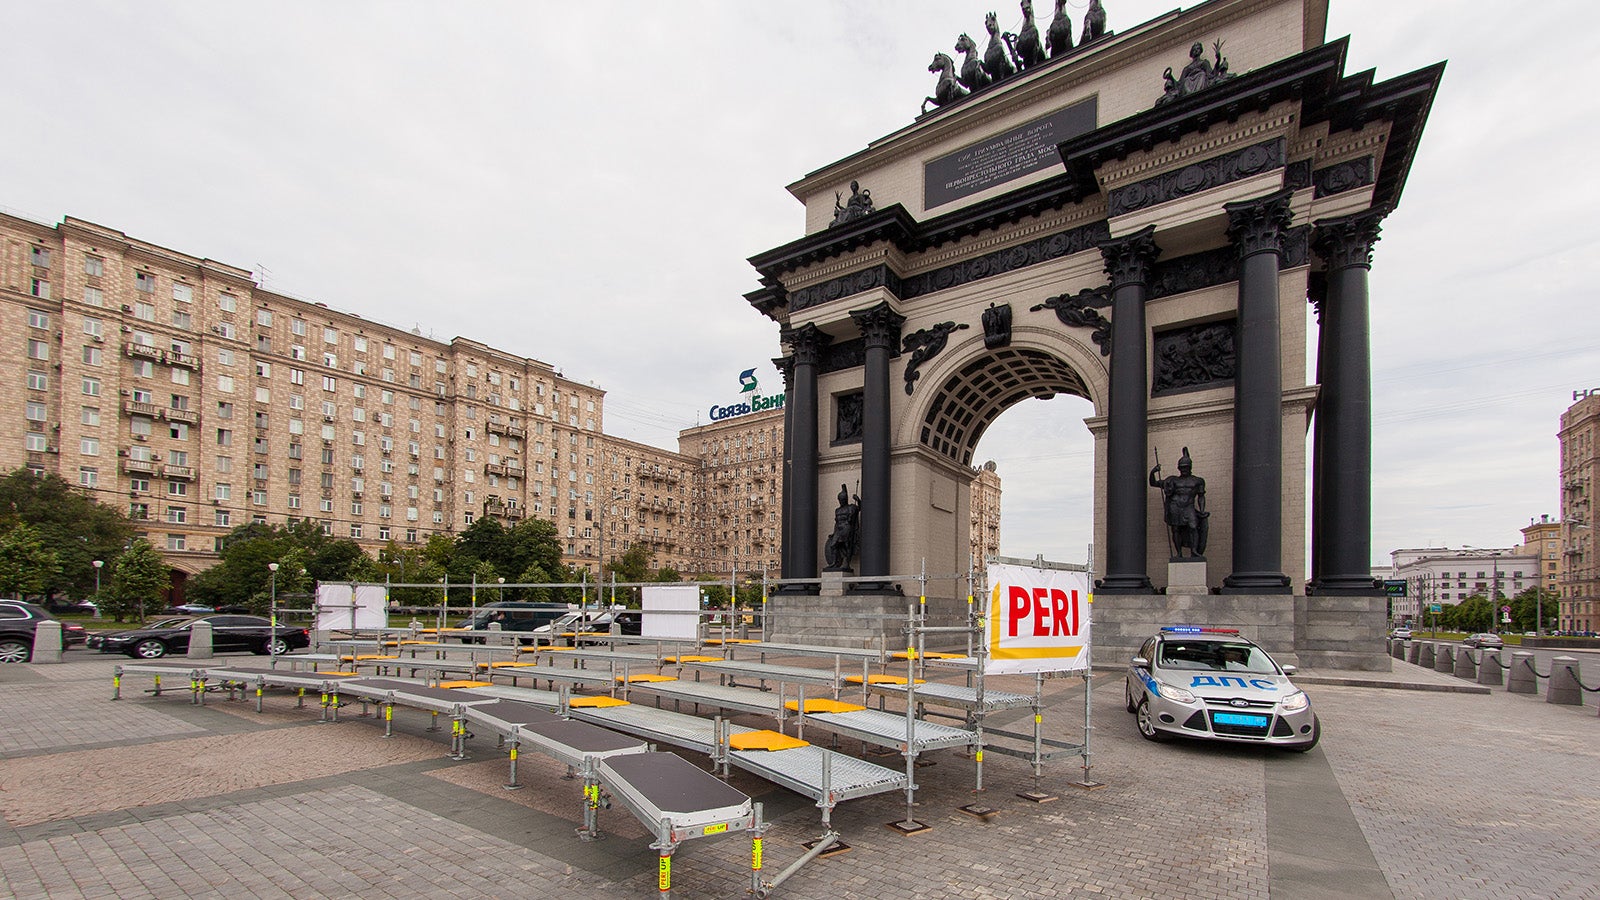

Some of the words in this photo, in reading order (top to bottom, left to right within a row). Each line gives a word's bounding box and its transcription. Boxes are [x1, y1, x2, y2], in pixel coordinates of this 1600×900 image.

[1008, 585, 1080, 637] PERI
[1190, 676, 1278, 690] ДПС
[660, 858, 667, 870] UP
